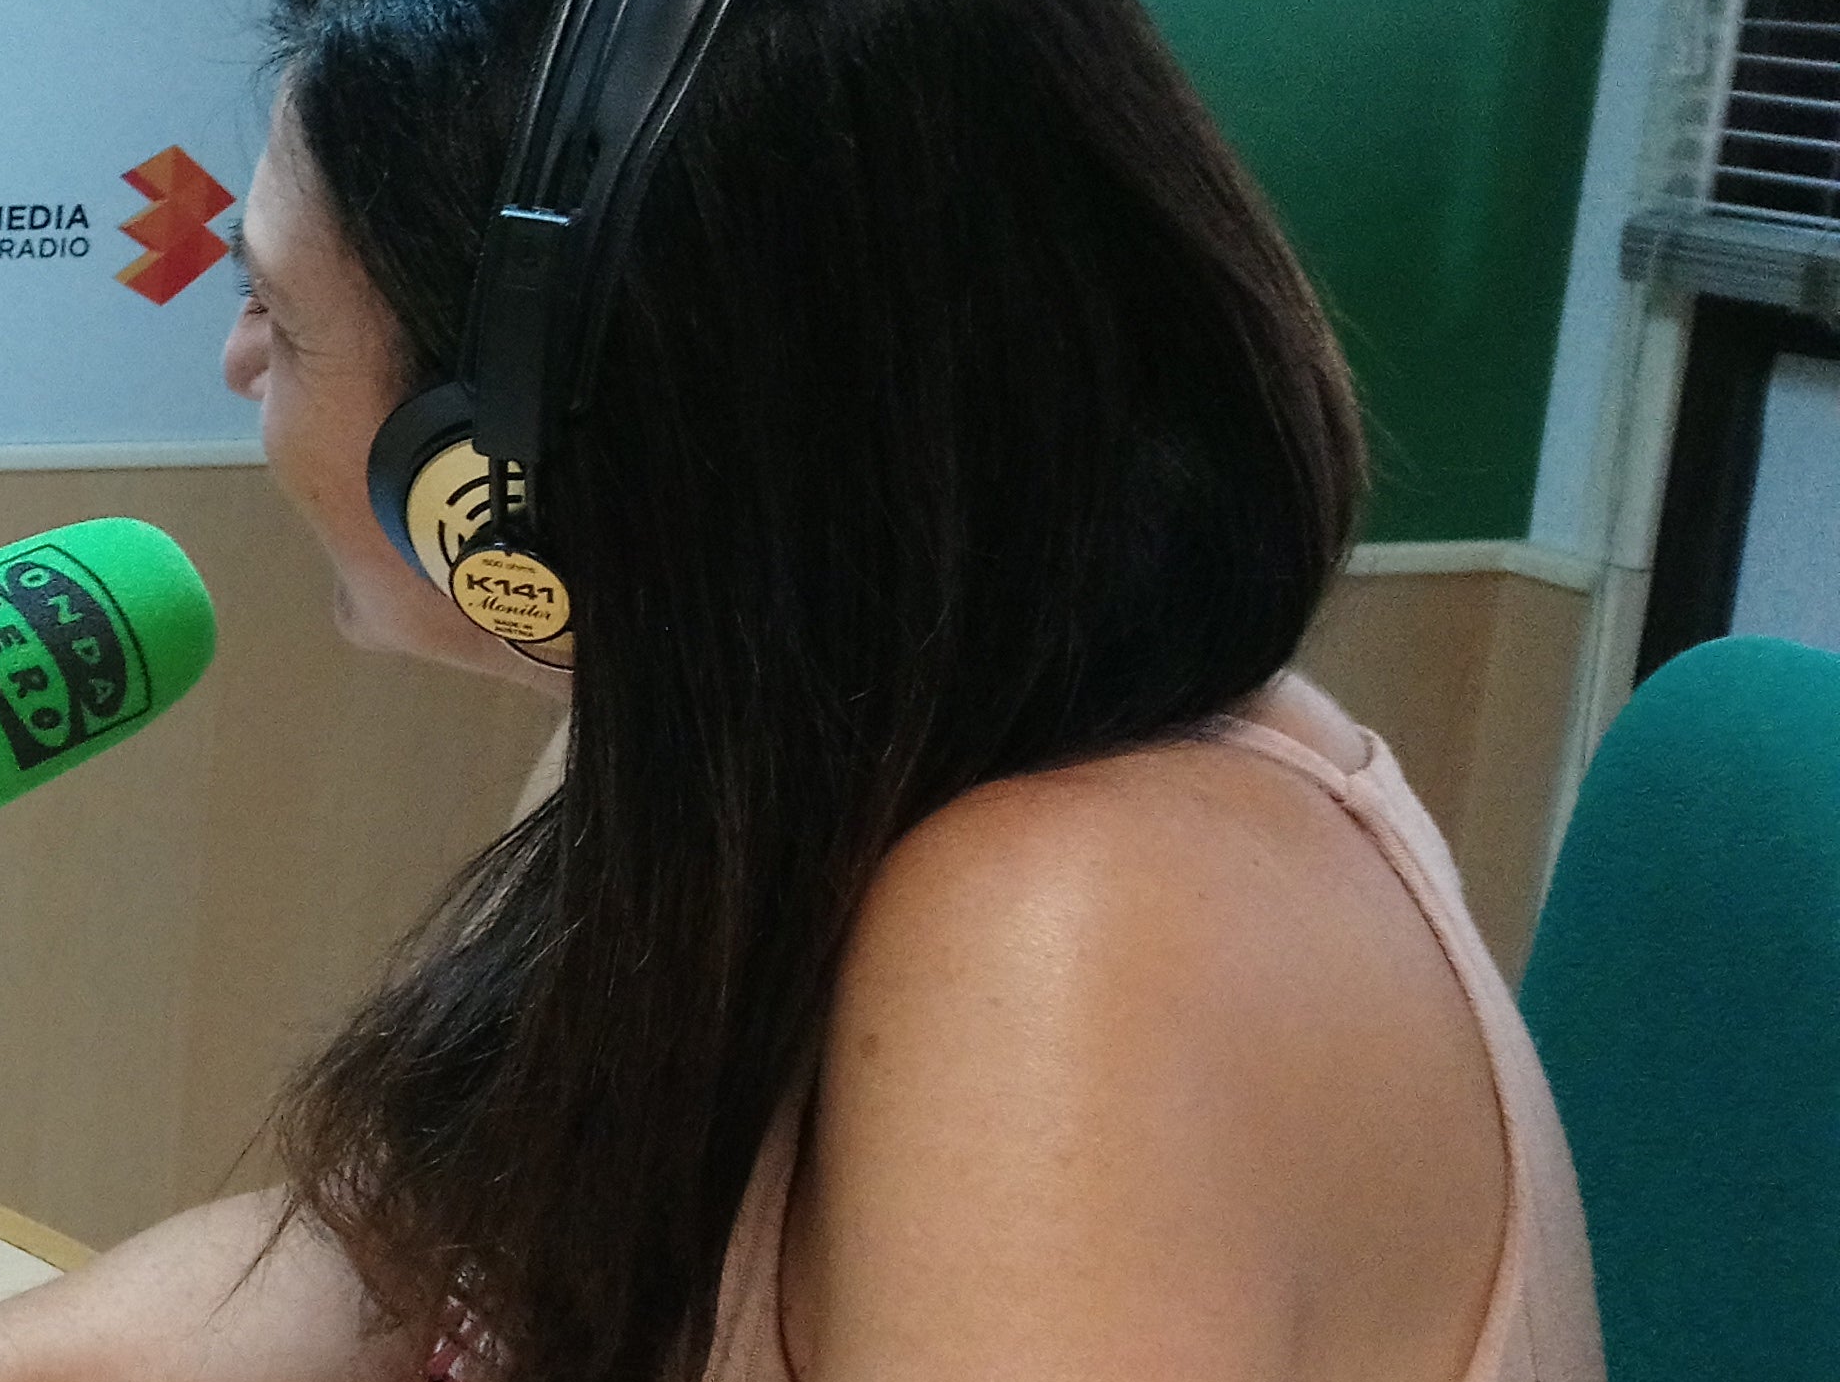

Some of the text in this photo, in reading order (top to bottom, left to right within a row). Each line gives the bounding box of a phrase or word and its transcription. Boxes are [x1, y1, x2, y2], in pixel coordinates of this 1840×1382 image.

[466, 573, 555, 604] K141
[468, 595, 553, 621] Monitor
[19, 567, 116, 705] ONDA
